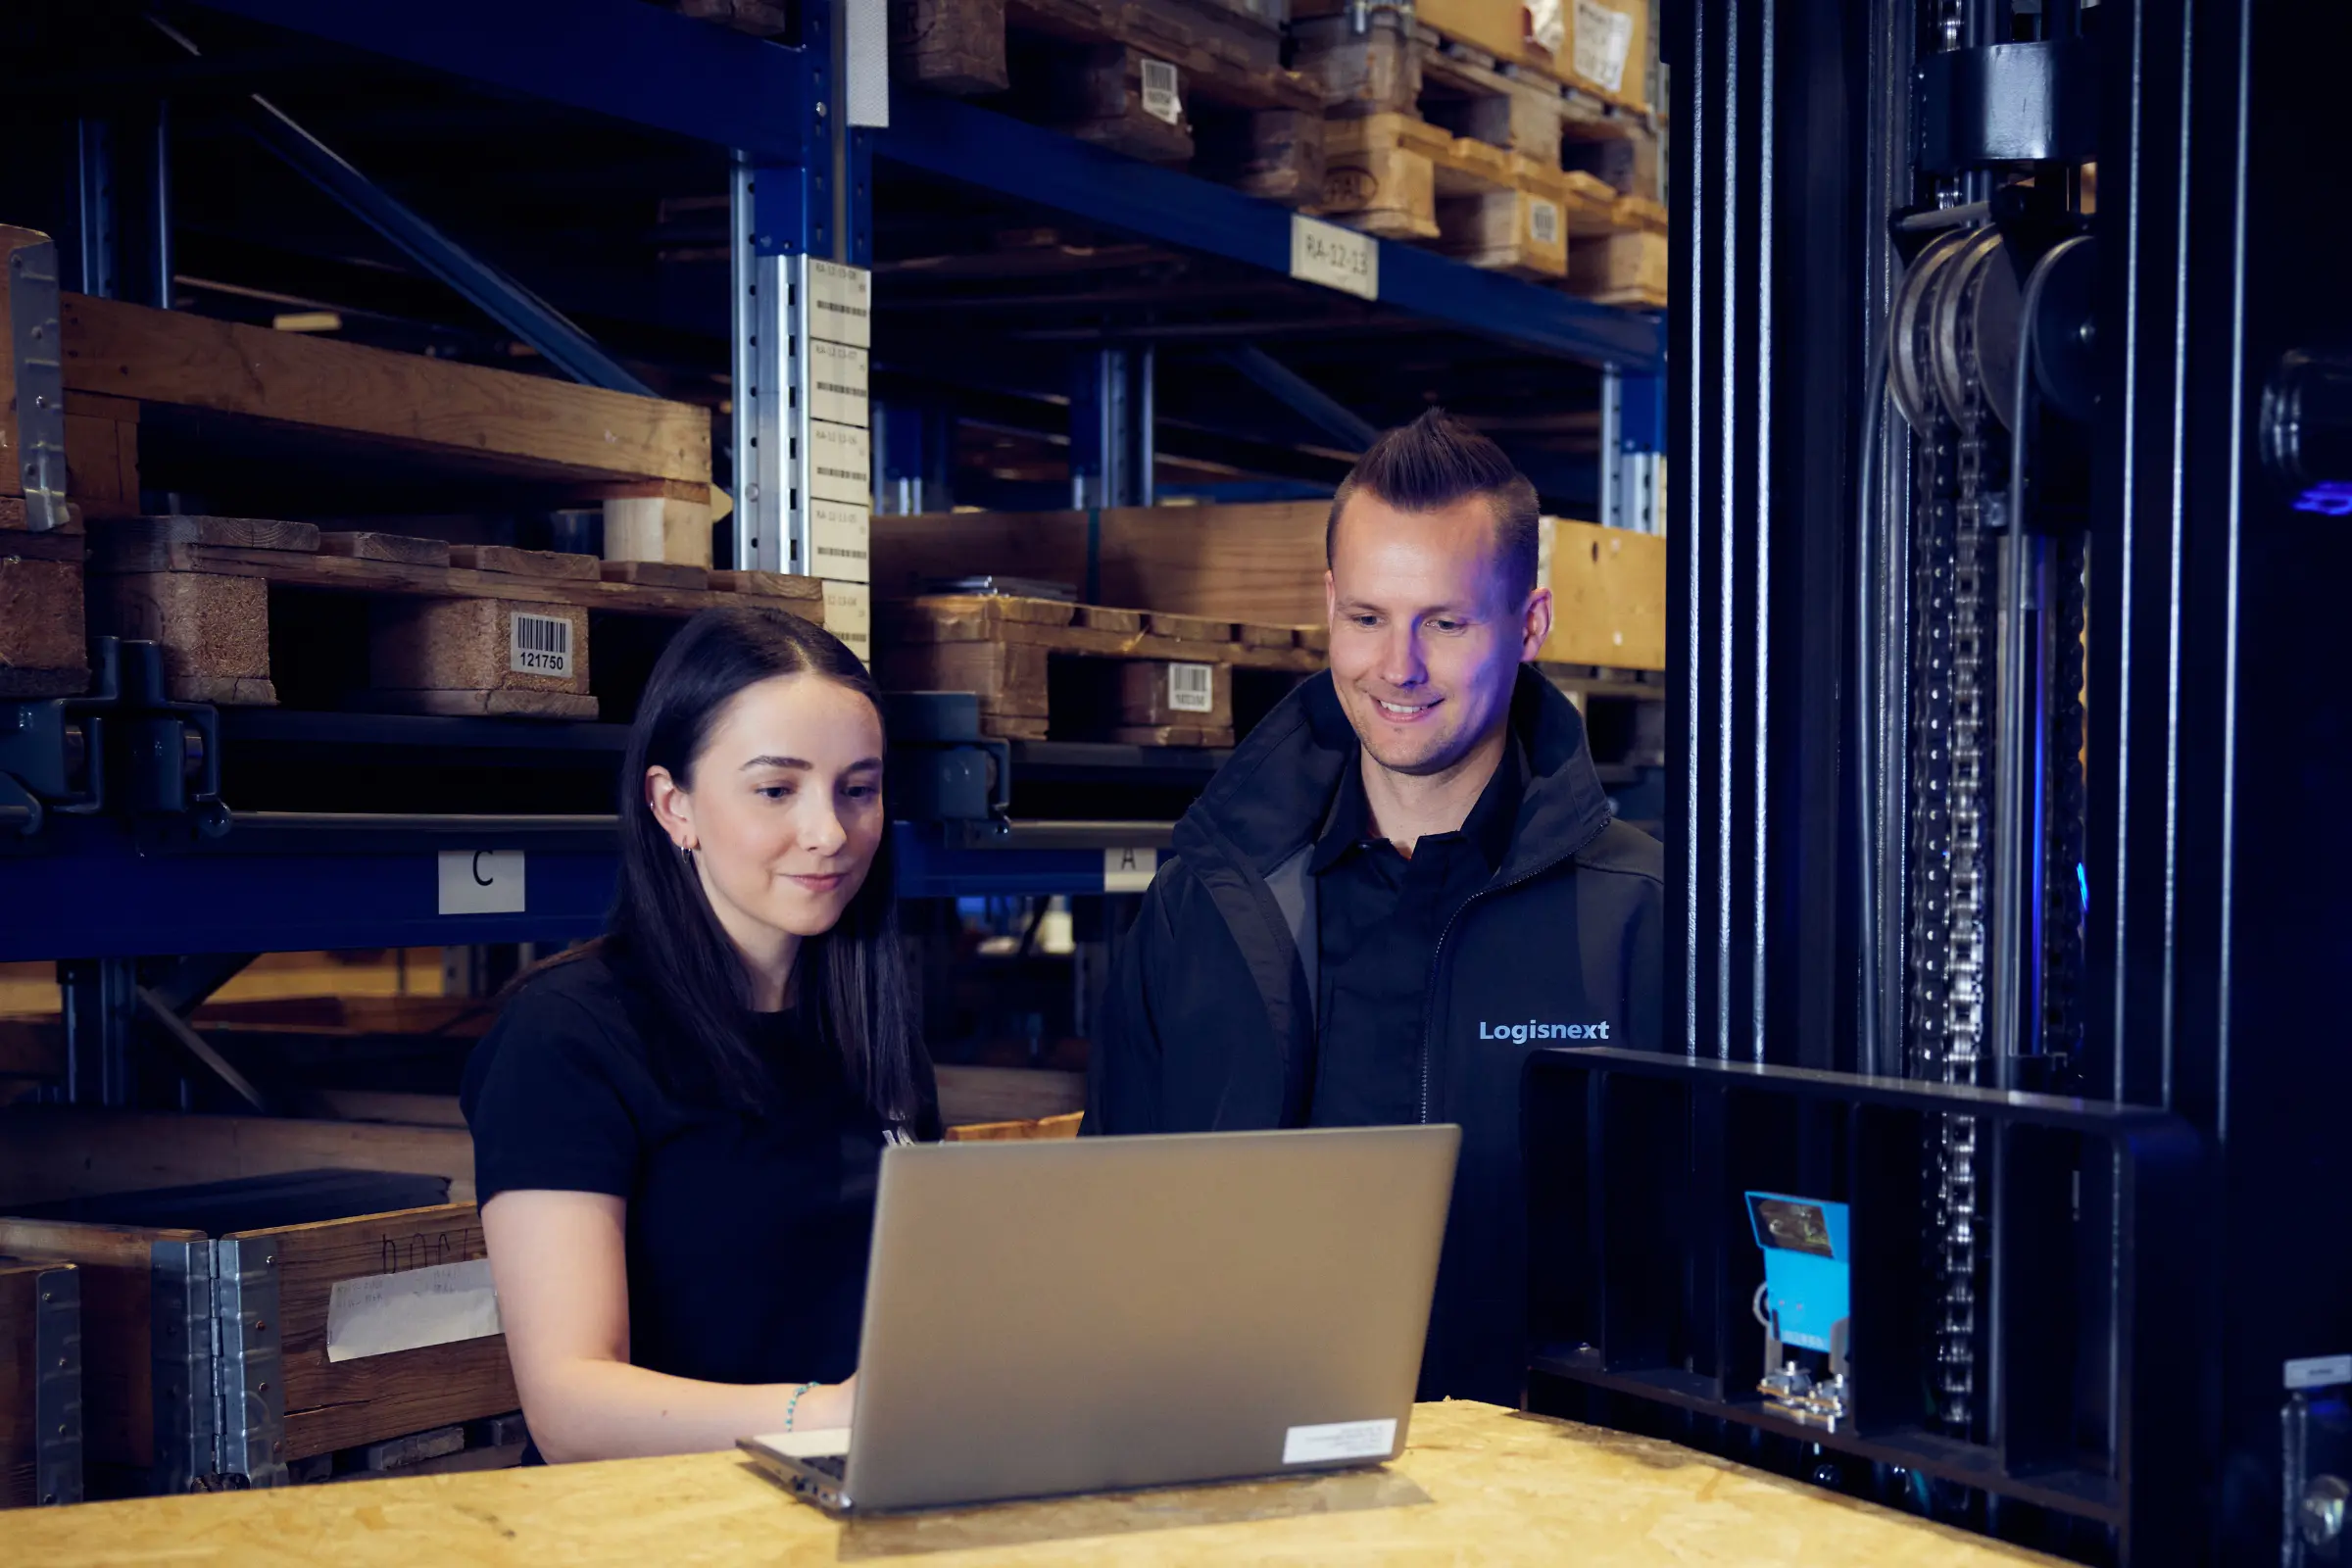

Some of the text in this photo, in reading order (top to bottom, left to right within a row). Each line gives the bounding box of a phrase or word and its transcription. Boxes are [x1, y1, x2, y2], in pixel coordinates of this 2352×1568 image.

[1305, 234, 1368, 275] RA-12-13
[520, 652, 564, 670] 121750
[472, 850, 494, 886] C
[1121, 847, 1136, 870] A
[1479, 1019, 1610, 1045] Logisnext
